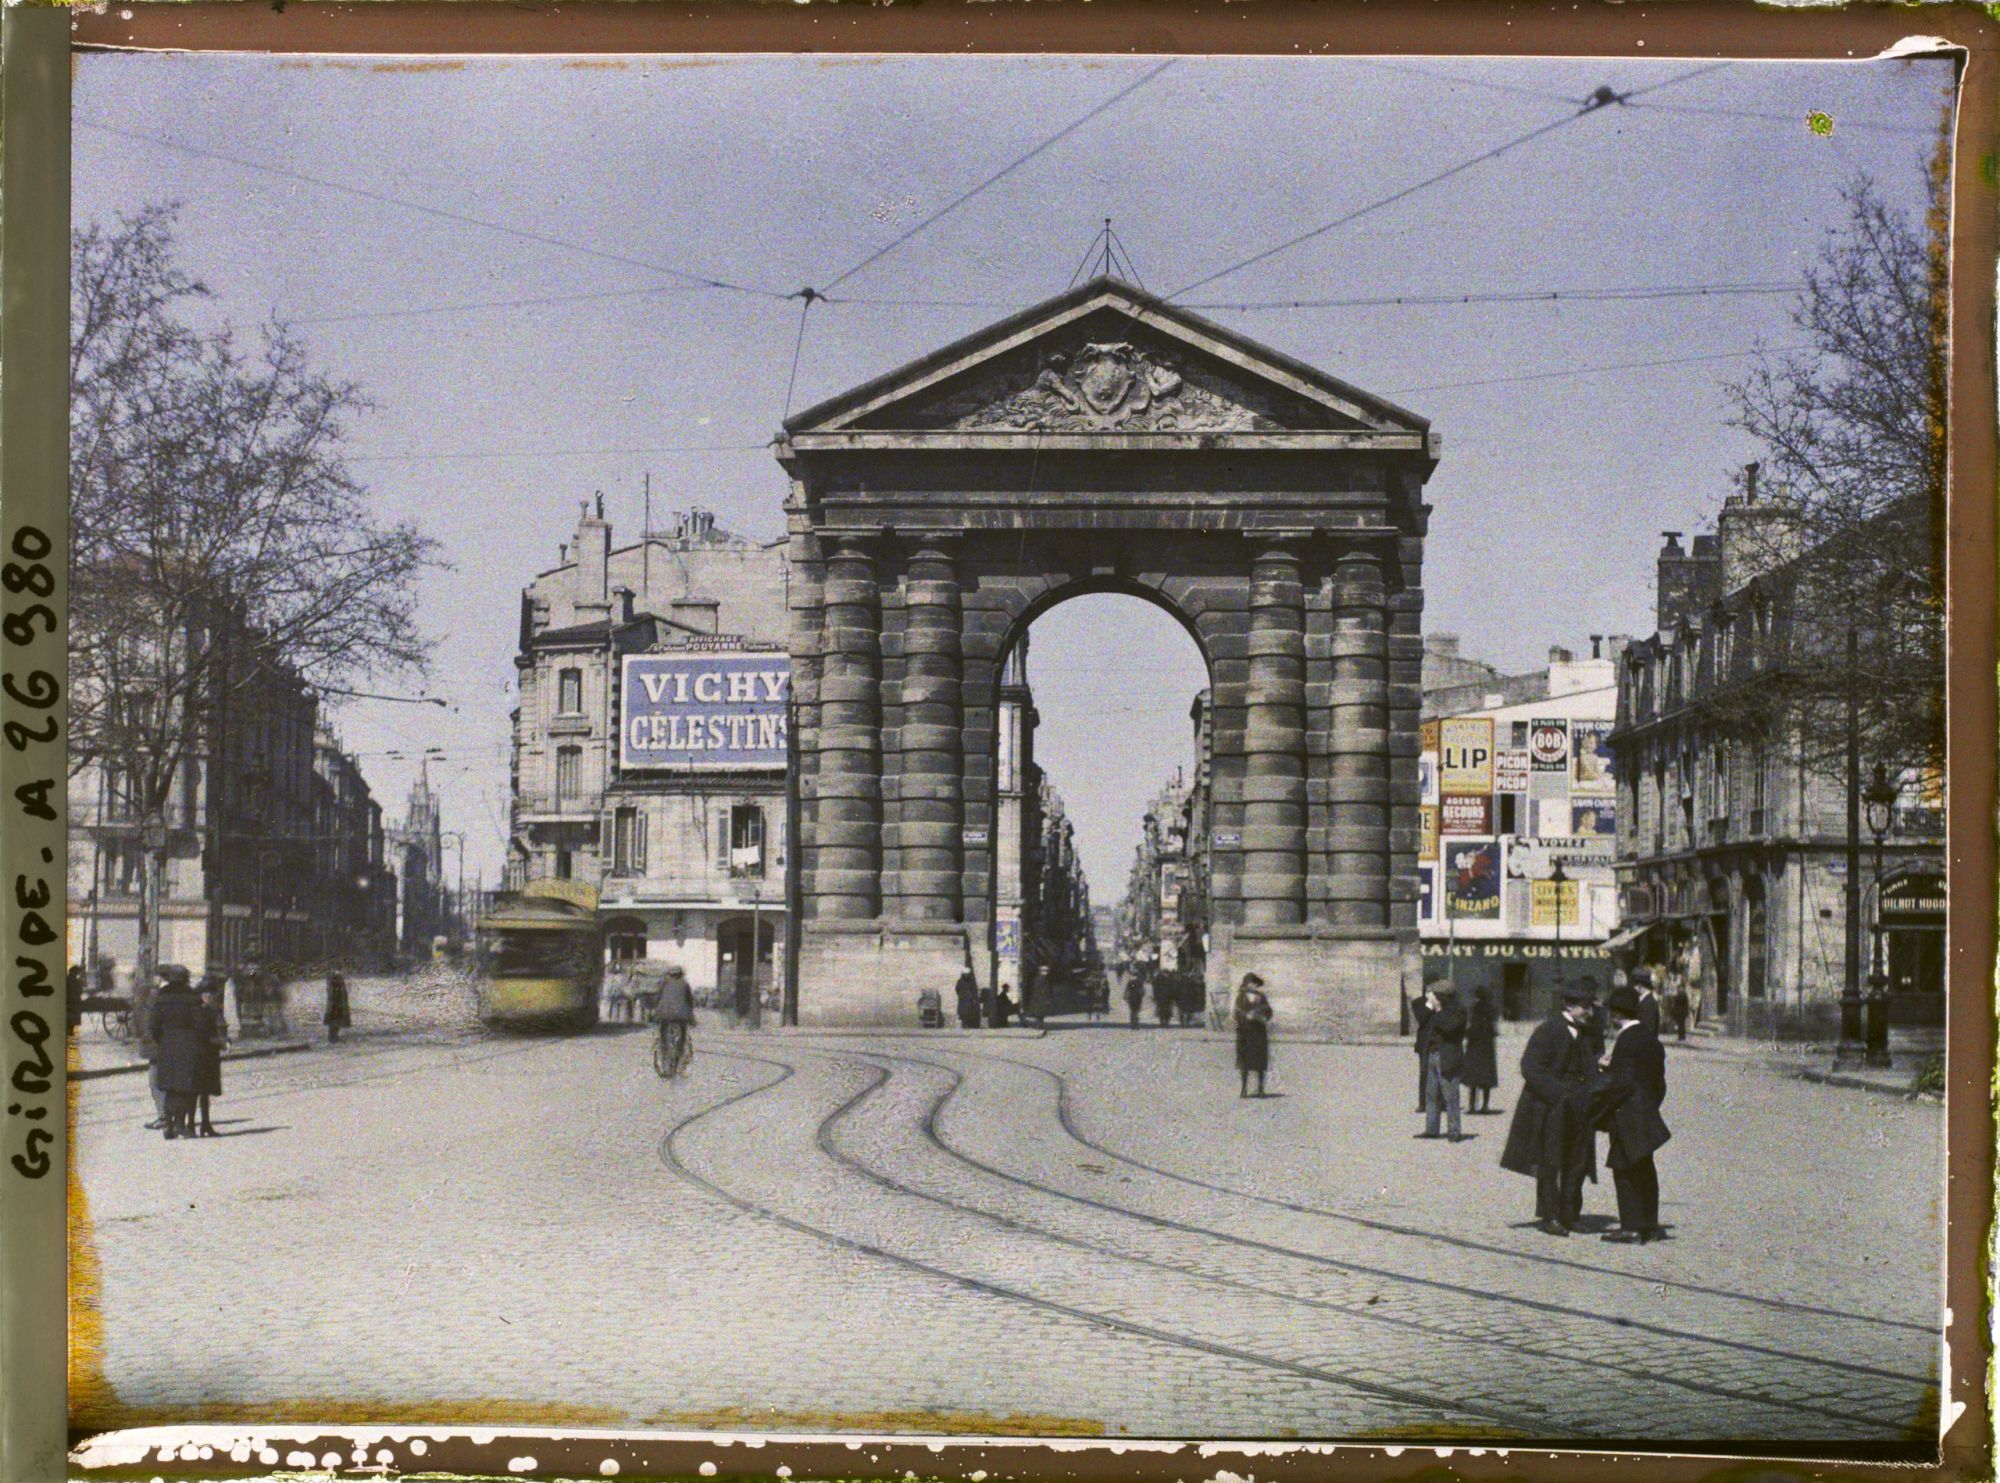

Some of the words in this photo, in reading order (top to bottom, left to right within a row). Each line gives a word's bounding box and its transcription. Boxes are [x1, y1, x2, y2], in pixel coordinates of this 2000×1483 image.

[640, 671, 790, 704] VICHY
[1537, 732, 1562, 749] BOB
[1446, 748, 1488, 769] LIP
[1496, 756, 1528, 769] PICON
[1496, 777, 1528, 790] PICON
[14, 778, 58, 822] A
[1446, 891, 1499, 912] CINZANO
